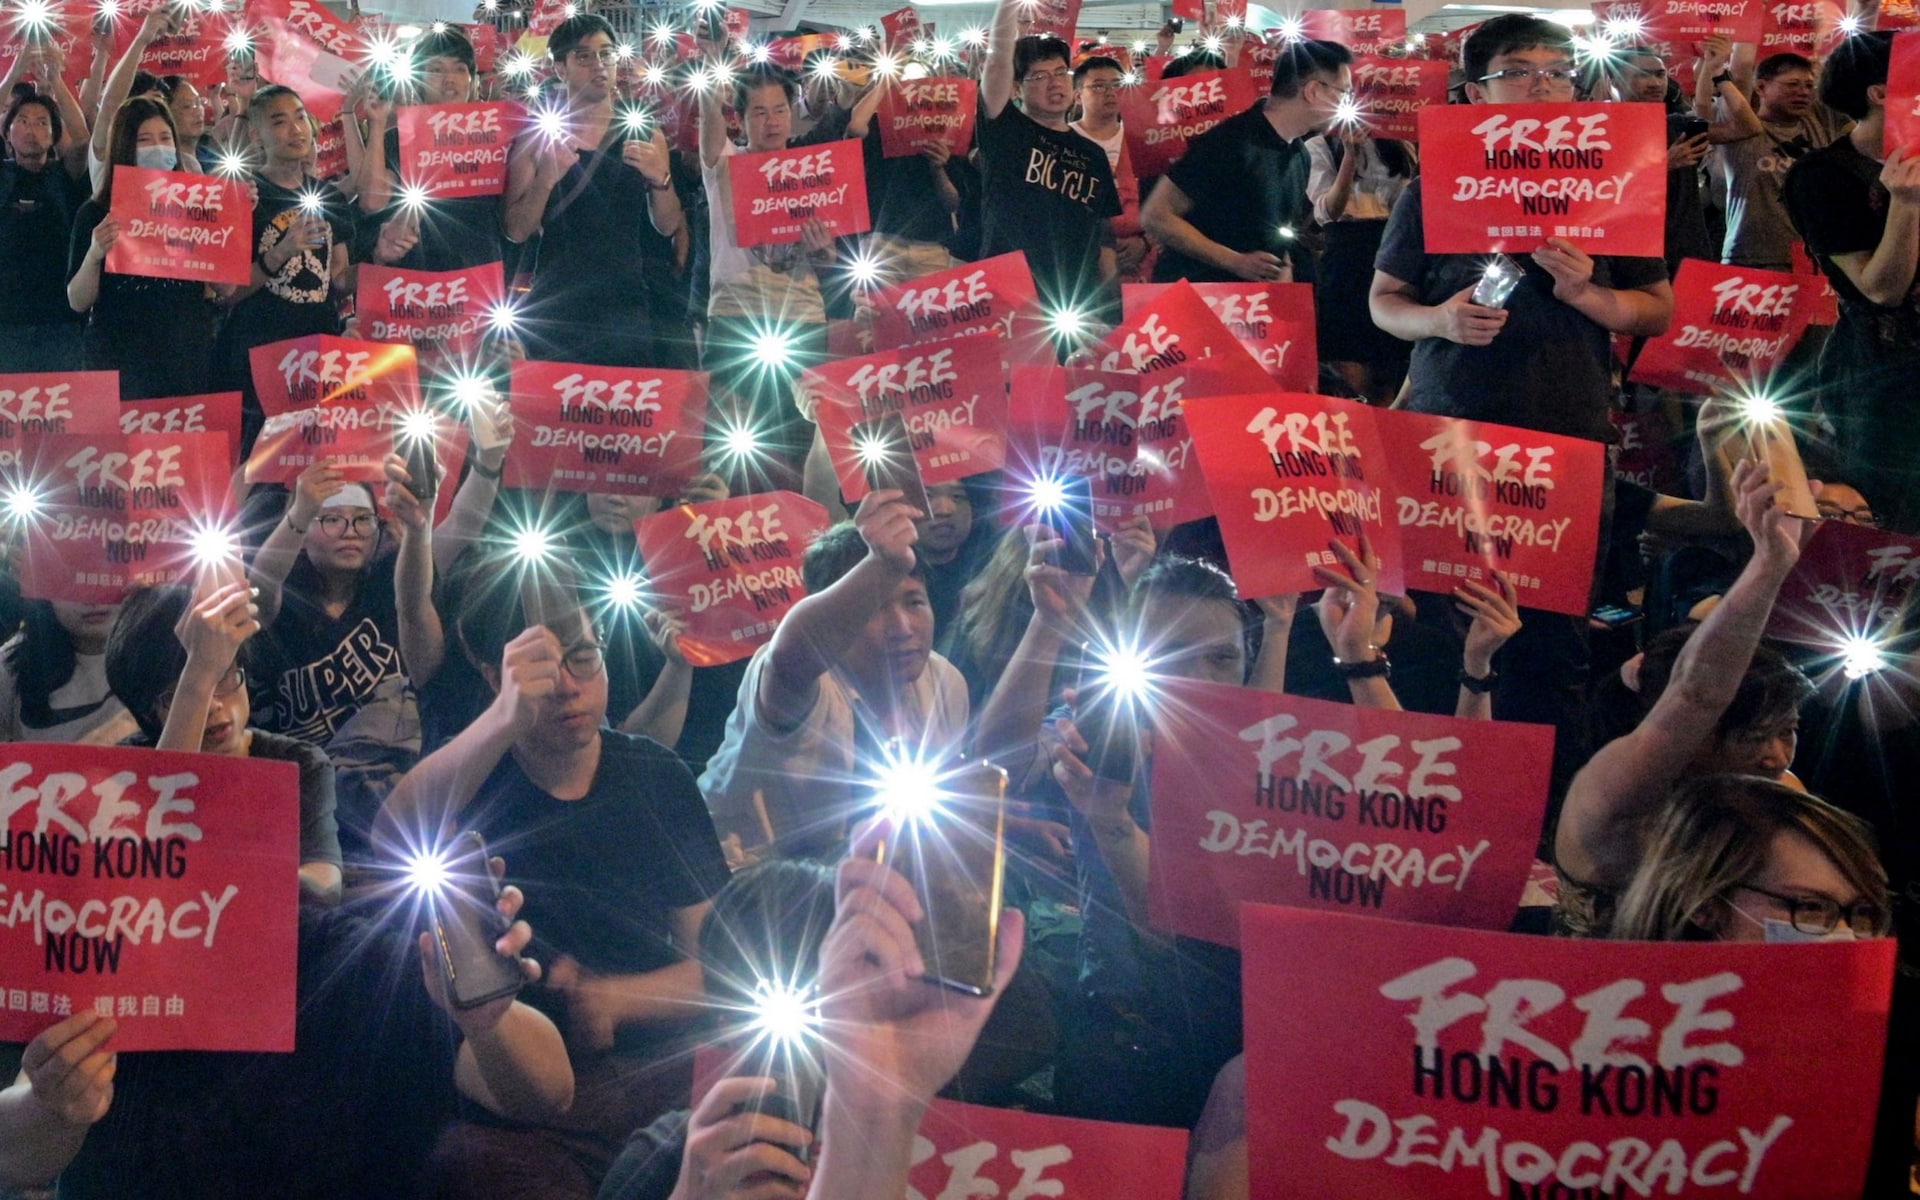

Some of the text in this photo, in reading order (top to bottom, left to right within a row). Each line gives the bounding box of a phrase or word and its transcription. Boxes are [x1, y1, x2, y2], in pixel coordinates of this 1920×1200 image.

[1665, 1, 1748, 16] DEMOCRACY
[1771, 3, 1825, 25] FREE
[287, 1, 352, 56] FREE
[1355, 64, 1422, 88] FREE
[900, 83, 960, 106] FREE
[1150, 77, 1227, 120] FREE
[427, 108, 502, 139] FREE
[893, 113, 966, 130] DEMOCRACY
[1471, 113, 1612, 159] FREE
[434, 130, 497, 147] HONG KONG
[417, 143, 513, 168] DEMOCRACY
[759, 150, 836, 184] FREE
[1485, 149, 1603, 170] HONG KONG
[767, 172, 832, 194] HONG KONG
[1025, 148, 1099, 204] BICYCLE
[1453, 172, 1634, 204] DEMOCRACY
[145, 177, 223, 211] FREE
[751, 183, 849, 215] DEMOCRACY
[1523, 196, 1570, 216] NOW
[186, 206, 218, 223] KONG
[790, 208, 816, 220] NOW
[128, 219, 235, 248] DEMOCRACY
[383, 277, 470, 308] FREE
[897, 270, 994, 326] FREE
[1712, 277, 1800, 318] FREE
[371, 315, 485, 340] DEMOCRACY
[389, 303, 425, 320] HONG
[909, 312, 948, 336] HONG
[952, 299, 992, 323] KONG
[1710, 310, 1783, 333] HONG KONG
[1673, 325, 1790, 360] DEMOCRACY
[278, 349, 372, 393] FREE
[847, 348, 957, 407] FREE
[0, 383, 73, 423] REE
[287, 382, 318, 403] HONG
[553, 373, 663, 411] FREE
[909, 381, 954, 406] KONG
[1065, 376, 1186, 429] FREE
[119, 403, 207, 433] FREE
[560, 405, 654, 428] HONG KONG
[1074, 418, 1133, 447] HONG
[303, 424, 338, 445] NOW
[531, 424, 677, 458] DEMOCRACY
[1246, 407, 1362, 464] FREE
[65, 445, 185, 494] FREE
[584, 447, 623, 465] NOW
[1042, 437, 1193, 480] DEMOCCY
[1270, 450, 1328, 479] HONG
[1419, 430, 1555, 489] FREE
[78, 484, 179, 511] HONG KONG
[1251, 486, 1383, 527] DEMOCRACY
[1496, 480, 1546, 510] KONG
[685, 504, 789, 560] FREE
[1396, 496, 1571, 553] DEMOCRACY
[106, 541, 148, 564] NOW
[752, 539, 793, 564] KONG
[1464, 530, 1513, 560] NW
[688, 565, 804, 613] DEMOCRA
[752, 587, 792, 612] NOW
[276, 617, 394, 730] SUPER
[1239, 713, 1463, 803] FREE
[1255, 771, 1449, 834] HONG KONG
[93, 835, 187, 879] KONG
[1200, 809, 1491, 892] DEMOCRACY
[1309, 864, 1387, 909] NOW
[45, 932, 124, 976] NOW
[1379, 956, 1746, 1077] FREE
[1412, 1045, 1720, 1118] HONG KONG
[1325, 1098, 1795, 1198] DEMOCRACY
